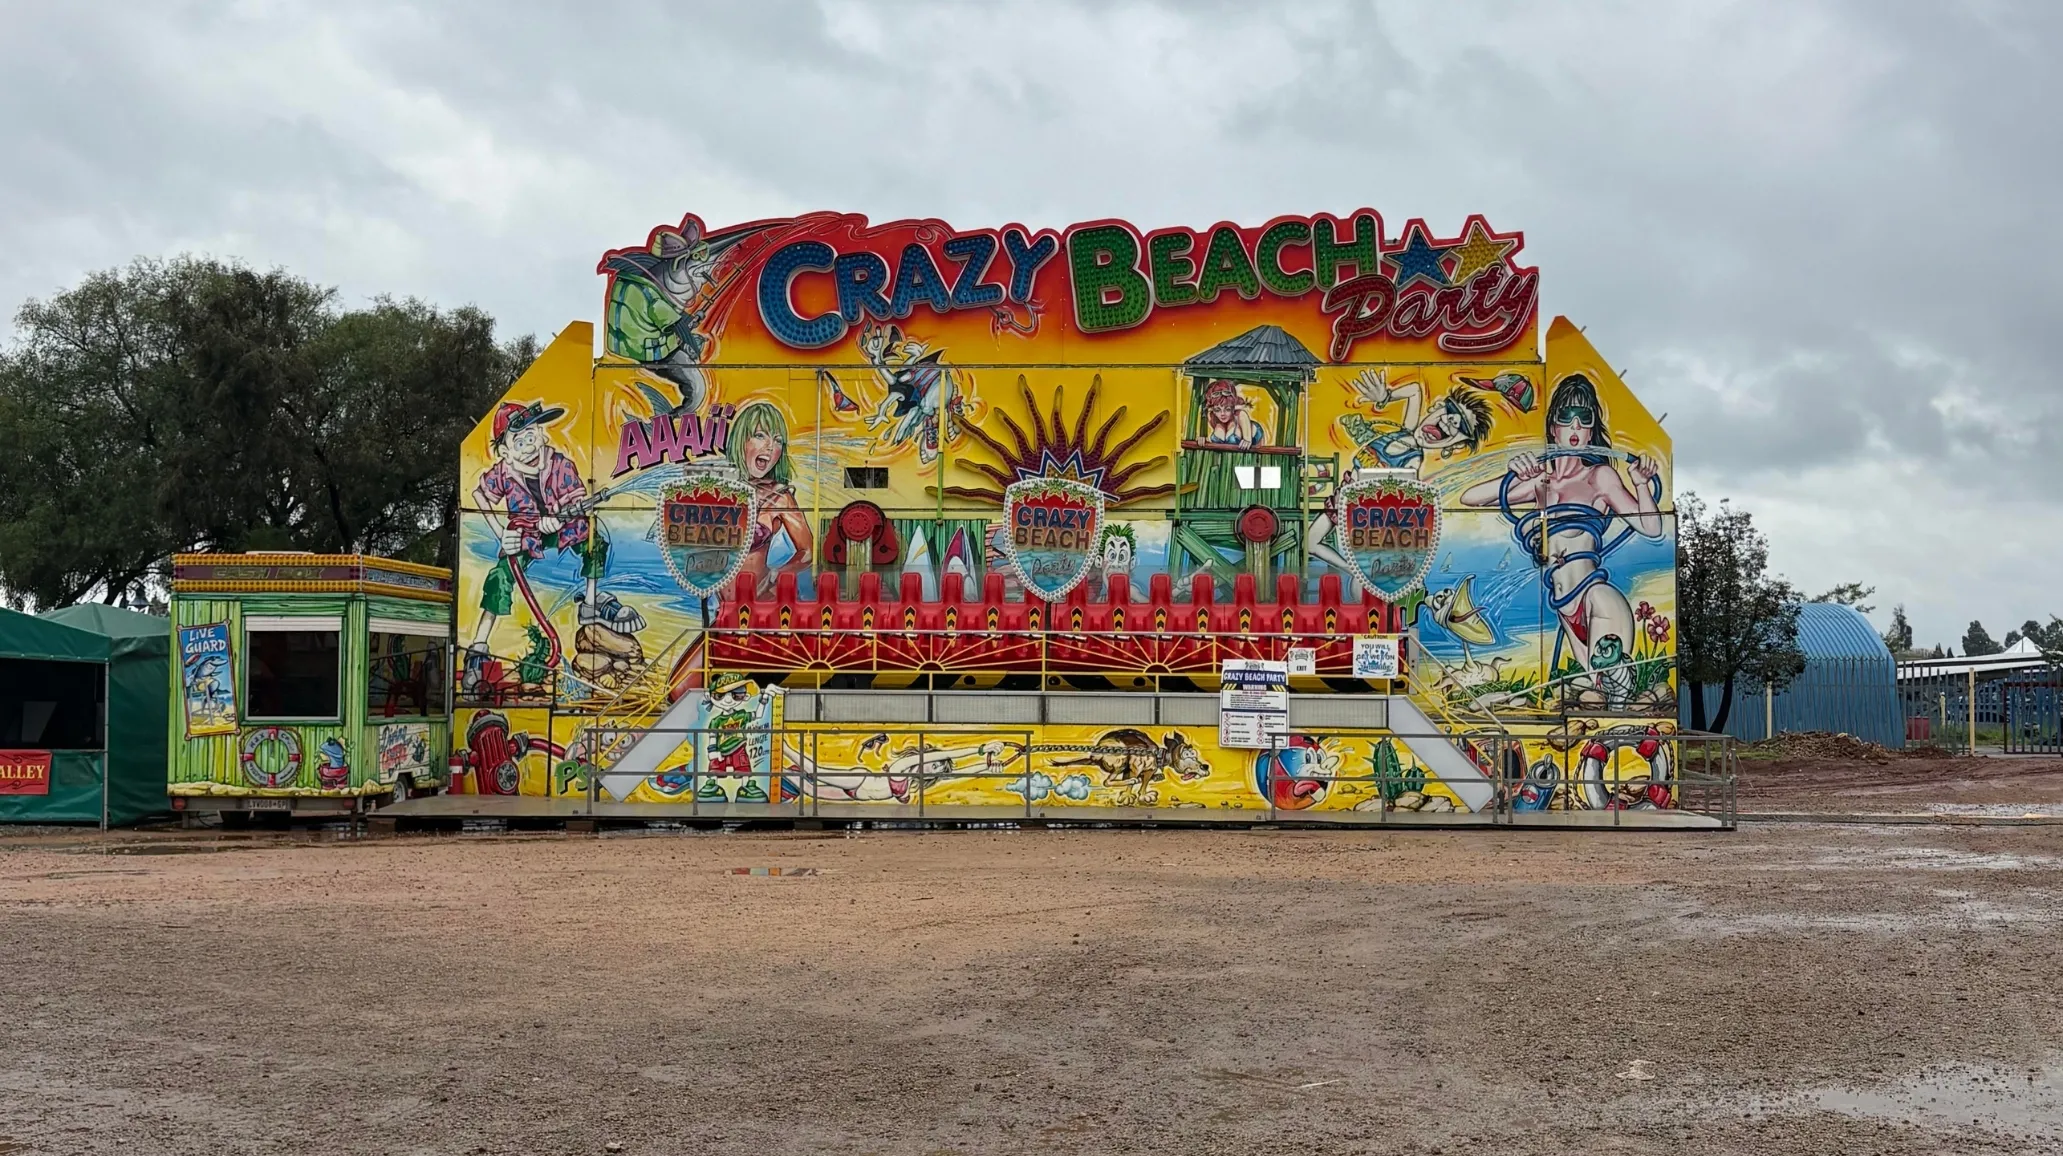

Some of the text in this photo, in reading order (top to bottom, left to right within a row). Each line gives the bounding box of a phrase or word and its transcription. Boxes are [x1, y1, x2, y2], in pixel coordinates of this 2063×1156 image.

[759, 213, 1378, 348] CRAZY BEACH
[1325, 263, 1539, 360] Party
[669, 504, 743, 526] CRAZY
[1017, 506, 1091, 529] CRAZY
[1352, 507, 1428, 528] CRAZY
[667, 524, 742, 546] BEACH
[1015, 527, 1090, 549] BEACH
[1352, 528, 1429, 549] BEACH
[685, 550, 729, 576] Party
[185, 639, 226, 654] GUARD
[1223, 672, 1285, 682] CRAZY BEACH PARTY
